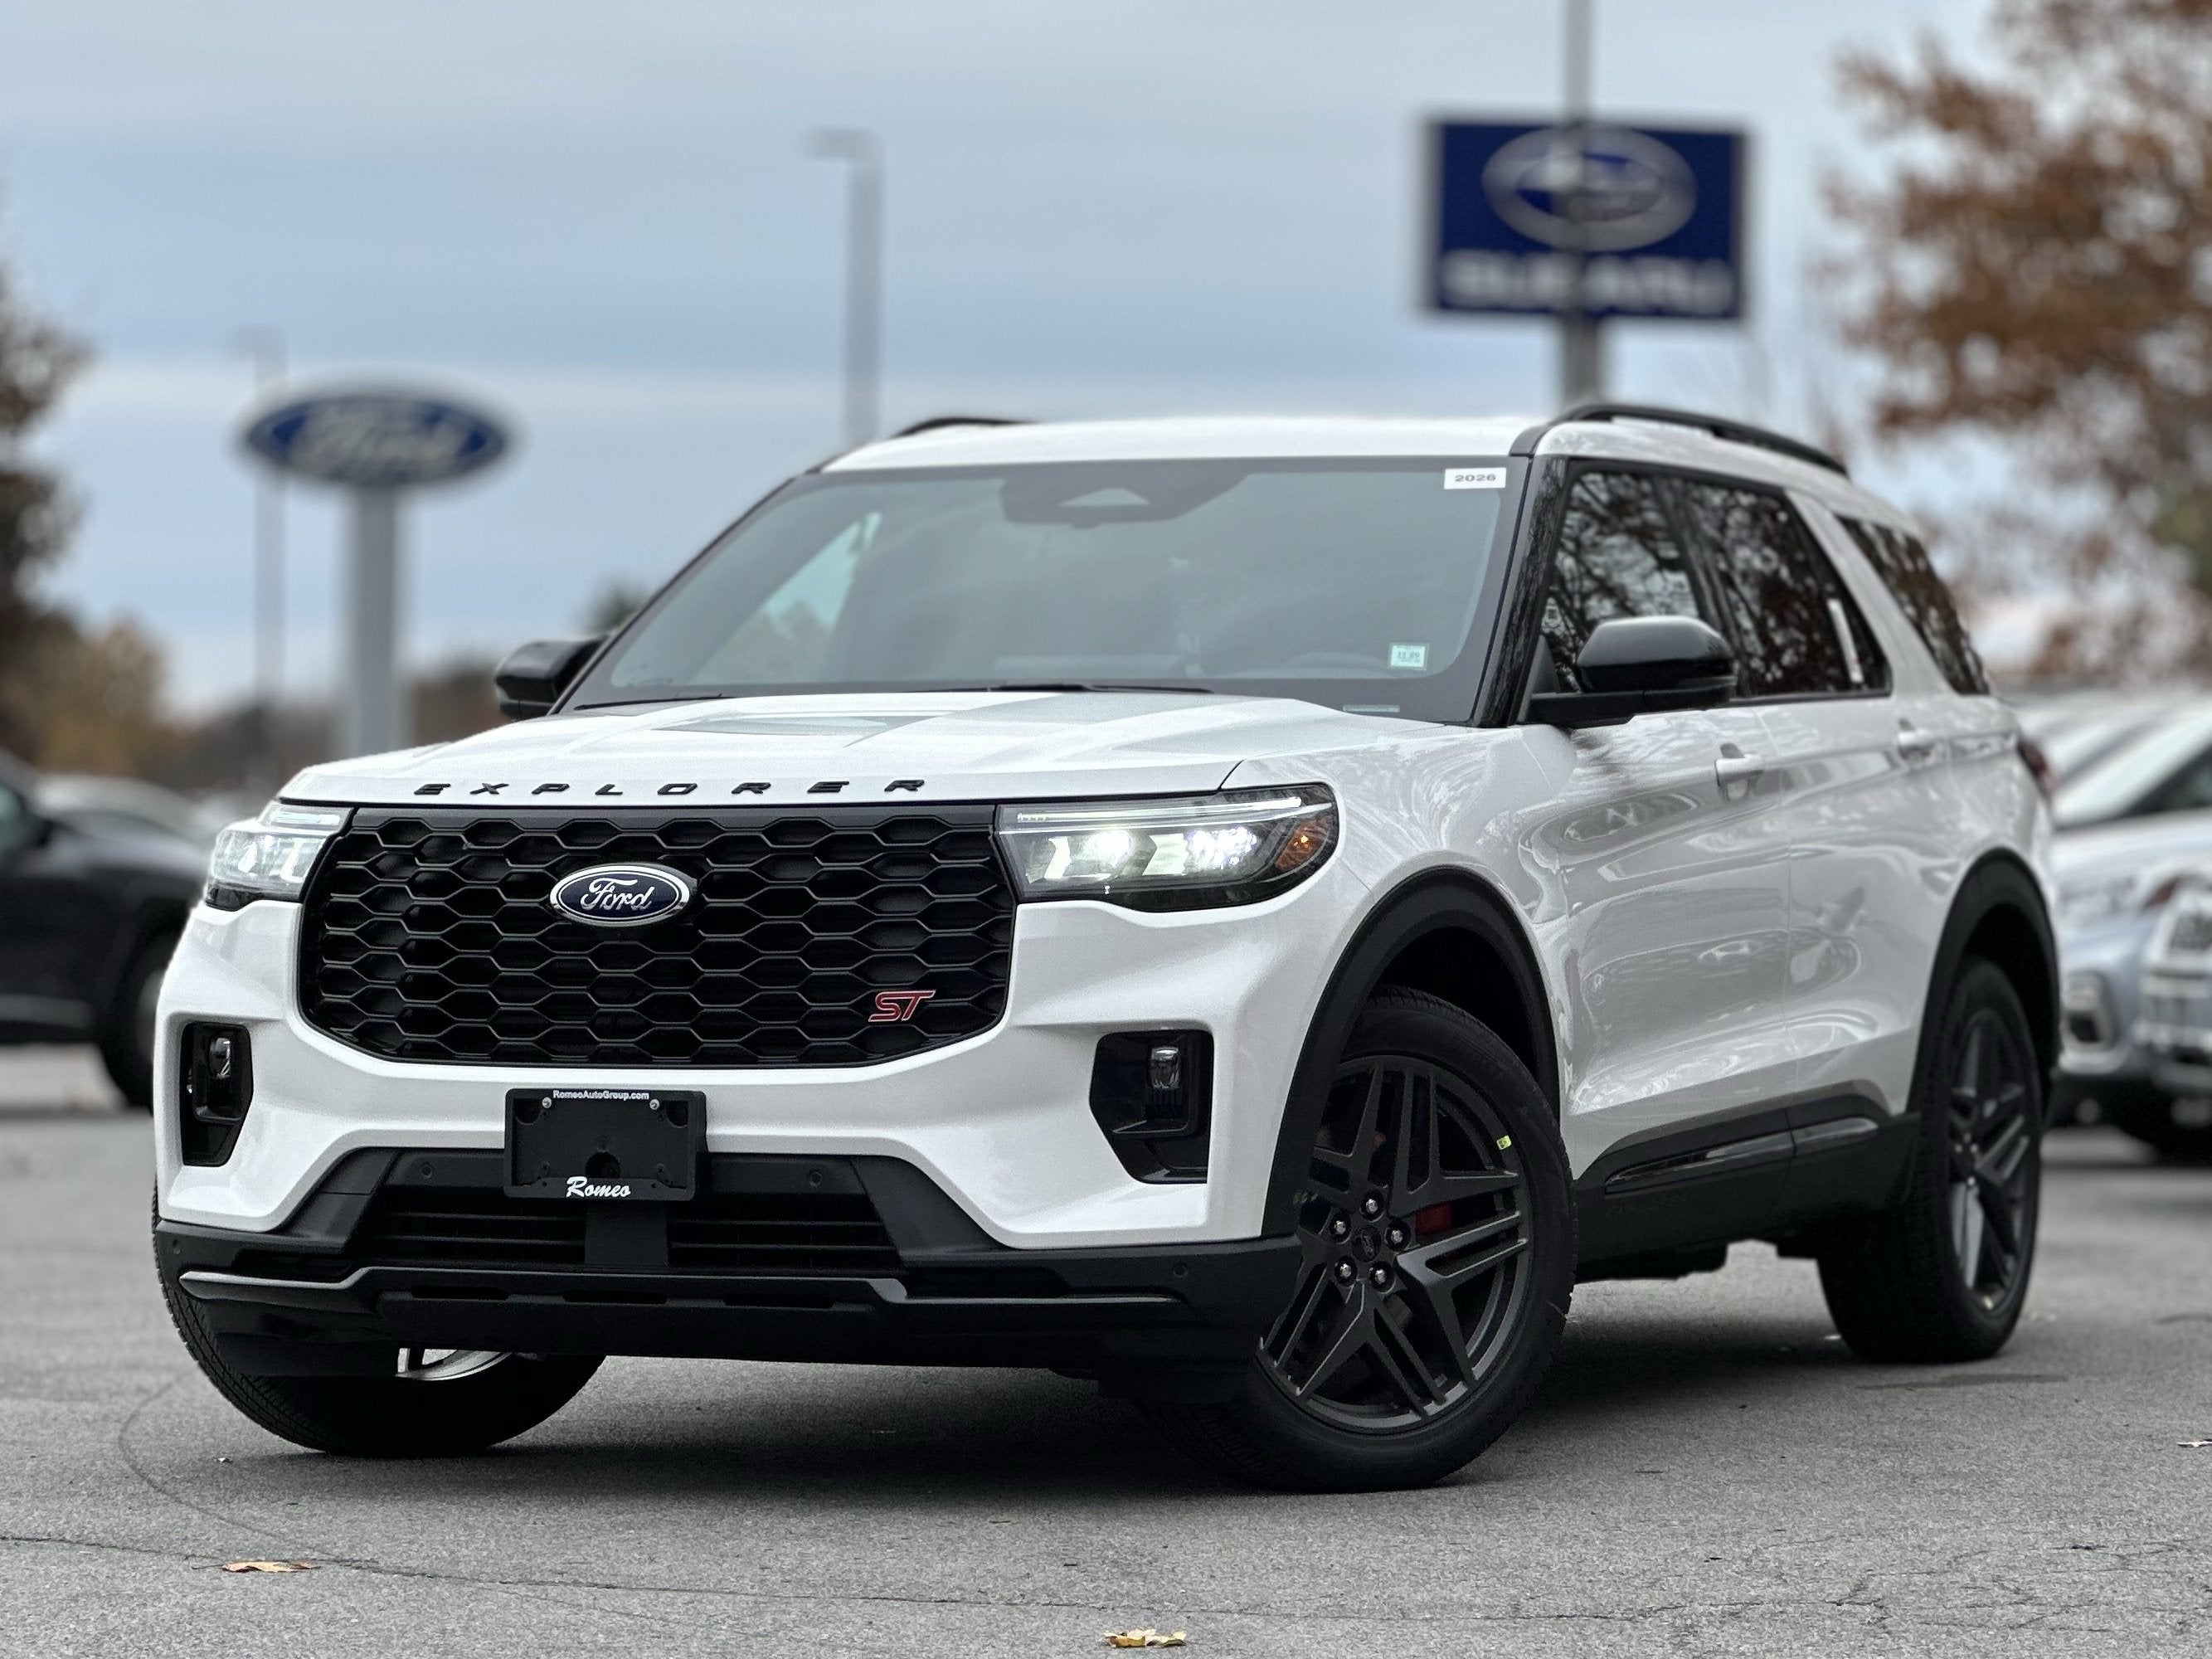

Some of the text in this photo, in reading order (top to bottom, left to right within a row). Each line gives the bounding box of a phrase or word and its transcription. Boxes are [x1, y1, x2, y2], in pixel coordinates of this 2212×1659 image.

[1455, 474, 1496, 482] 2026
[414, 779, 925, 796] EXPLORER
[580, 877, 655, 911] Ford
[868, 990, 936, 1022] ST
[552, 1090, 649, 1101] RomeoAutoGroup.com
[566, 1175, 631, 1198] Romeo
